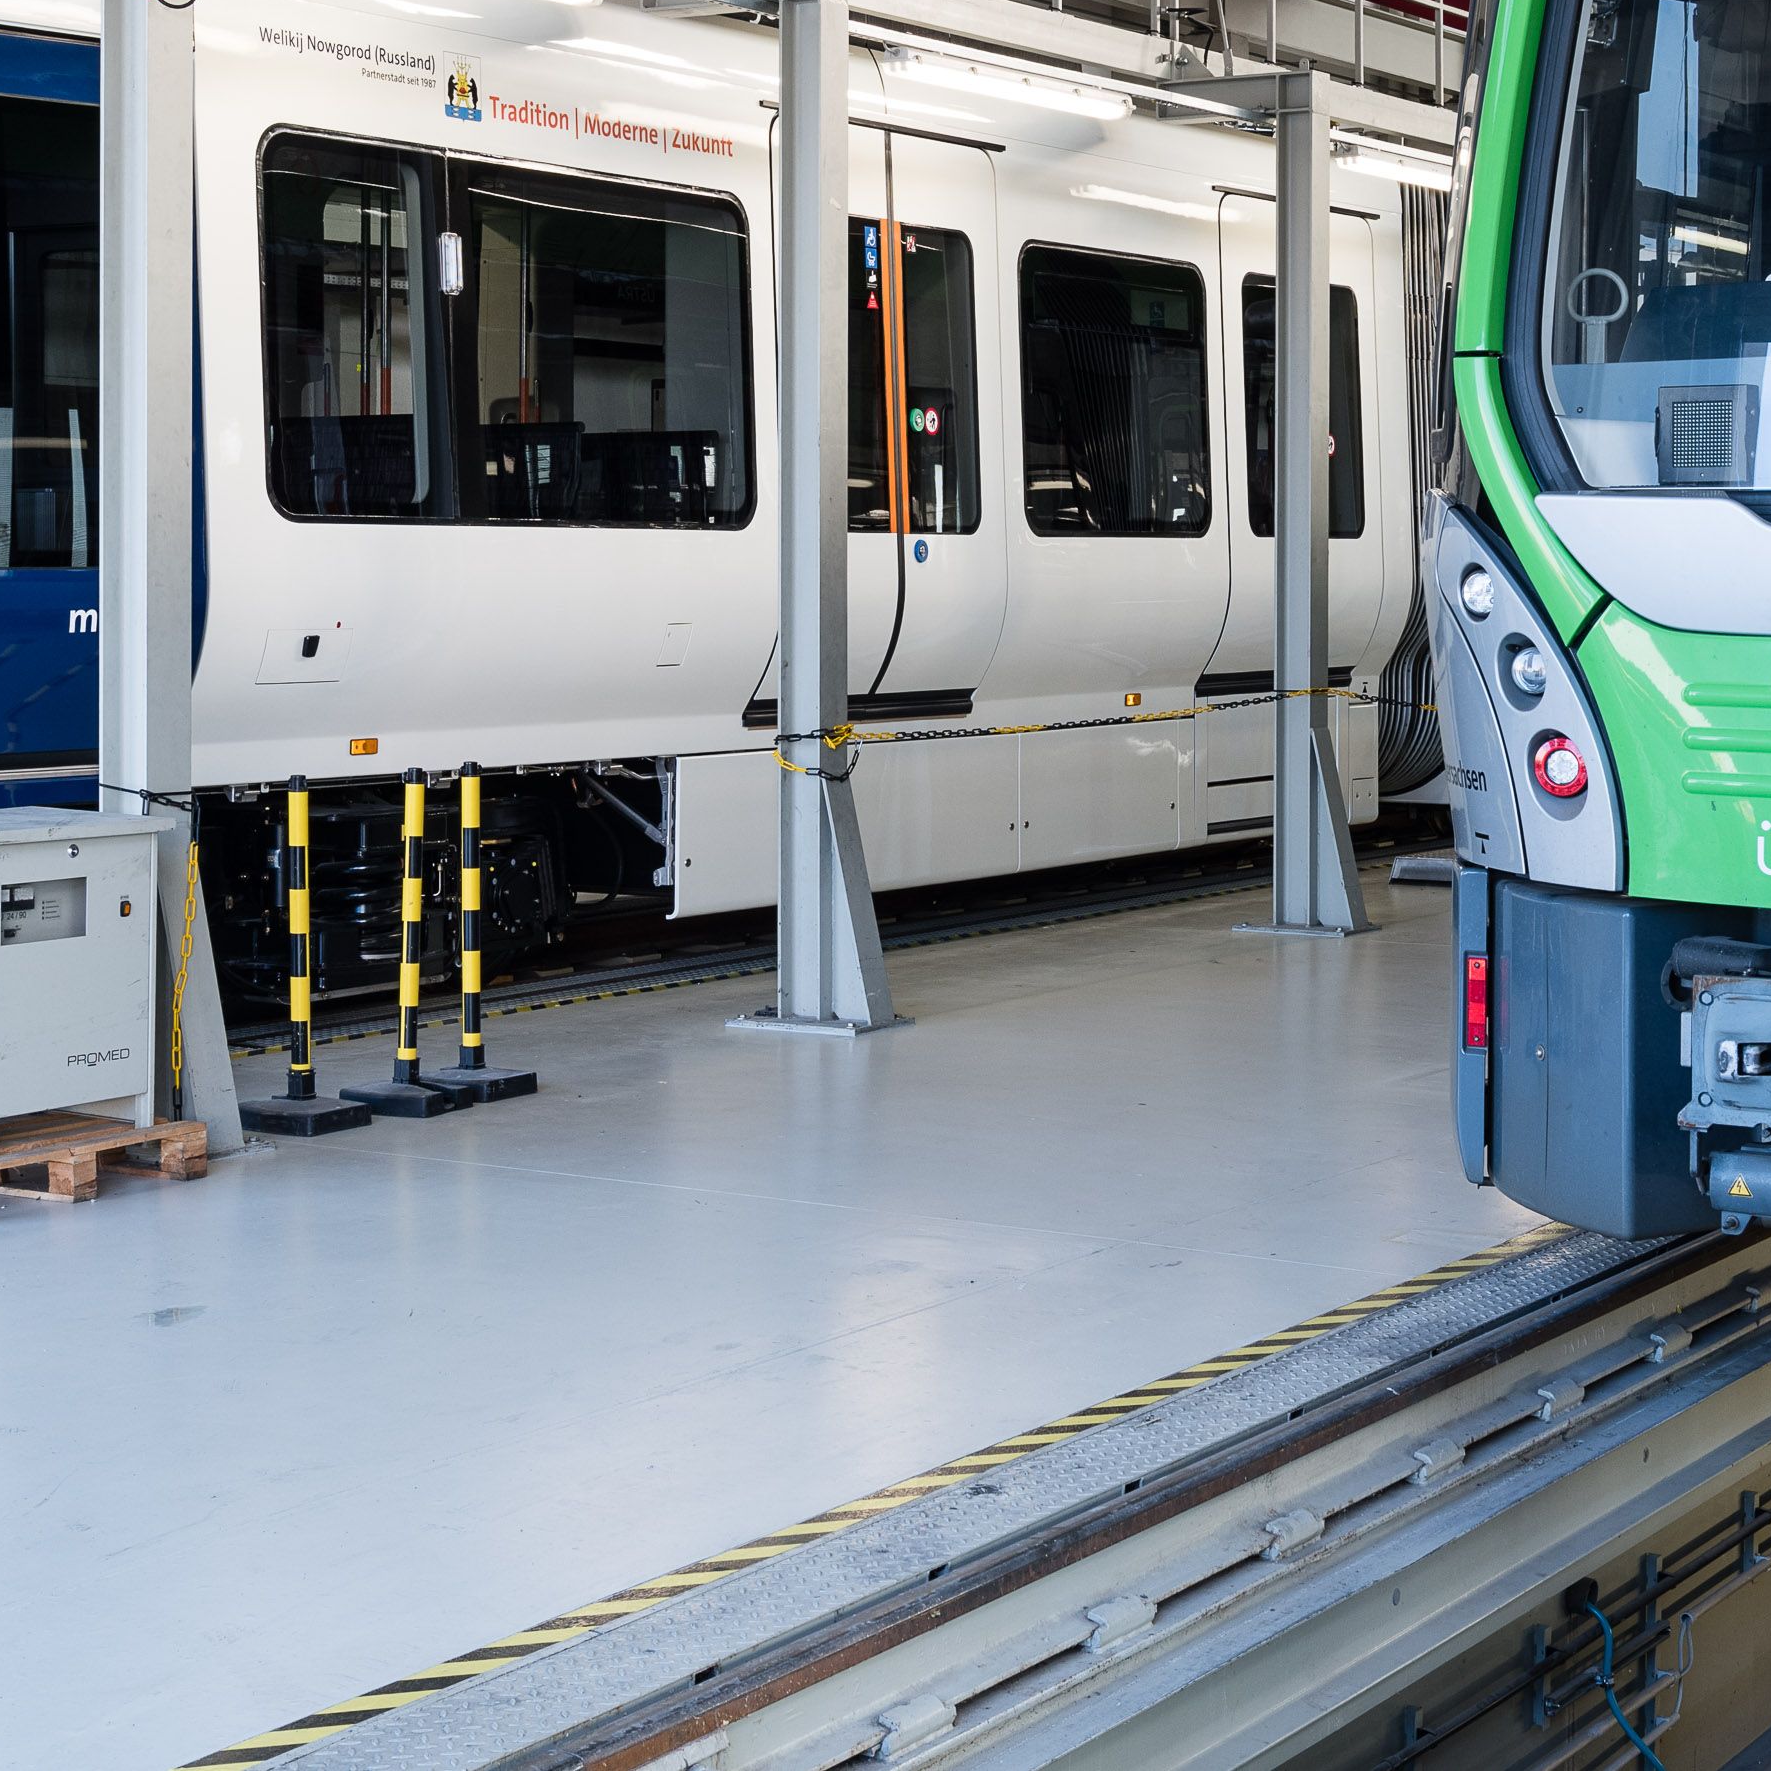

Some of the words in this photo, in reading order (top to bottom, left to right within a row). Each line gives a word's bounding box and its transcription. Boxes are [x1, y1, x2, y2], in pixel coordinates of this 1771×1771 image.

[259, 26, 303, 54] Welikij
[307, 34, 371, 60] Nowgorod
[375, 45, 436, 75] (Russland)
[361, 68, 406, 85] Partnerstadt
[406, 75, 420, 86] seit
[421, 77, 437, 89] 1987
[489, 95, 569, 131] Tradition
[584, 112, 659, 145] Moderne
[671, 128, 734, 157] Zukunft
[67, 1048, 130, 1067] PROMED
